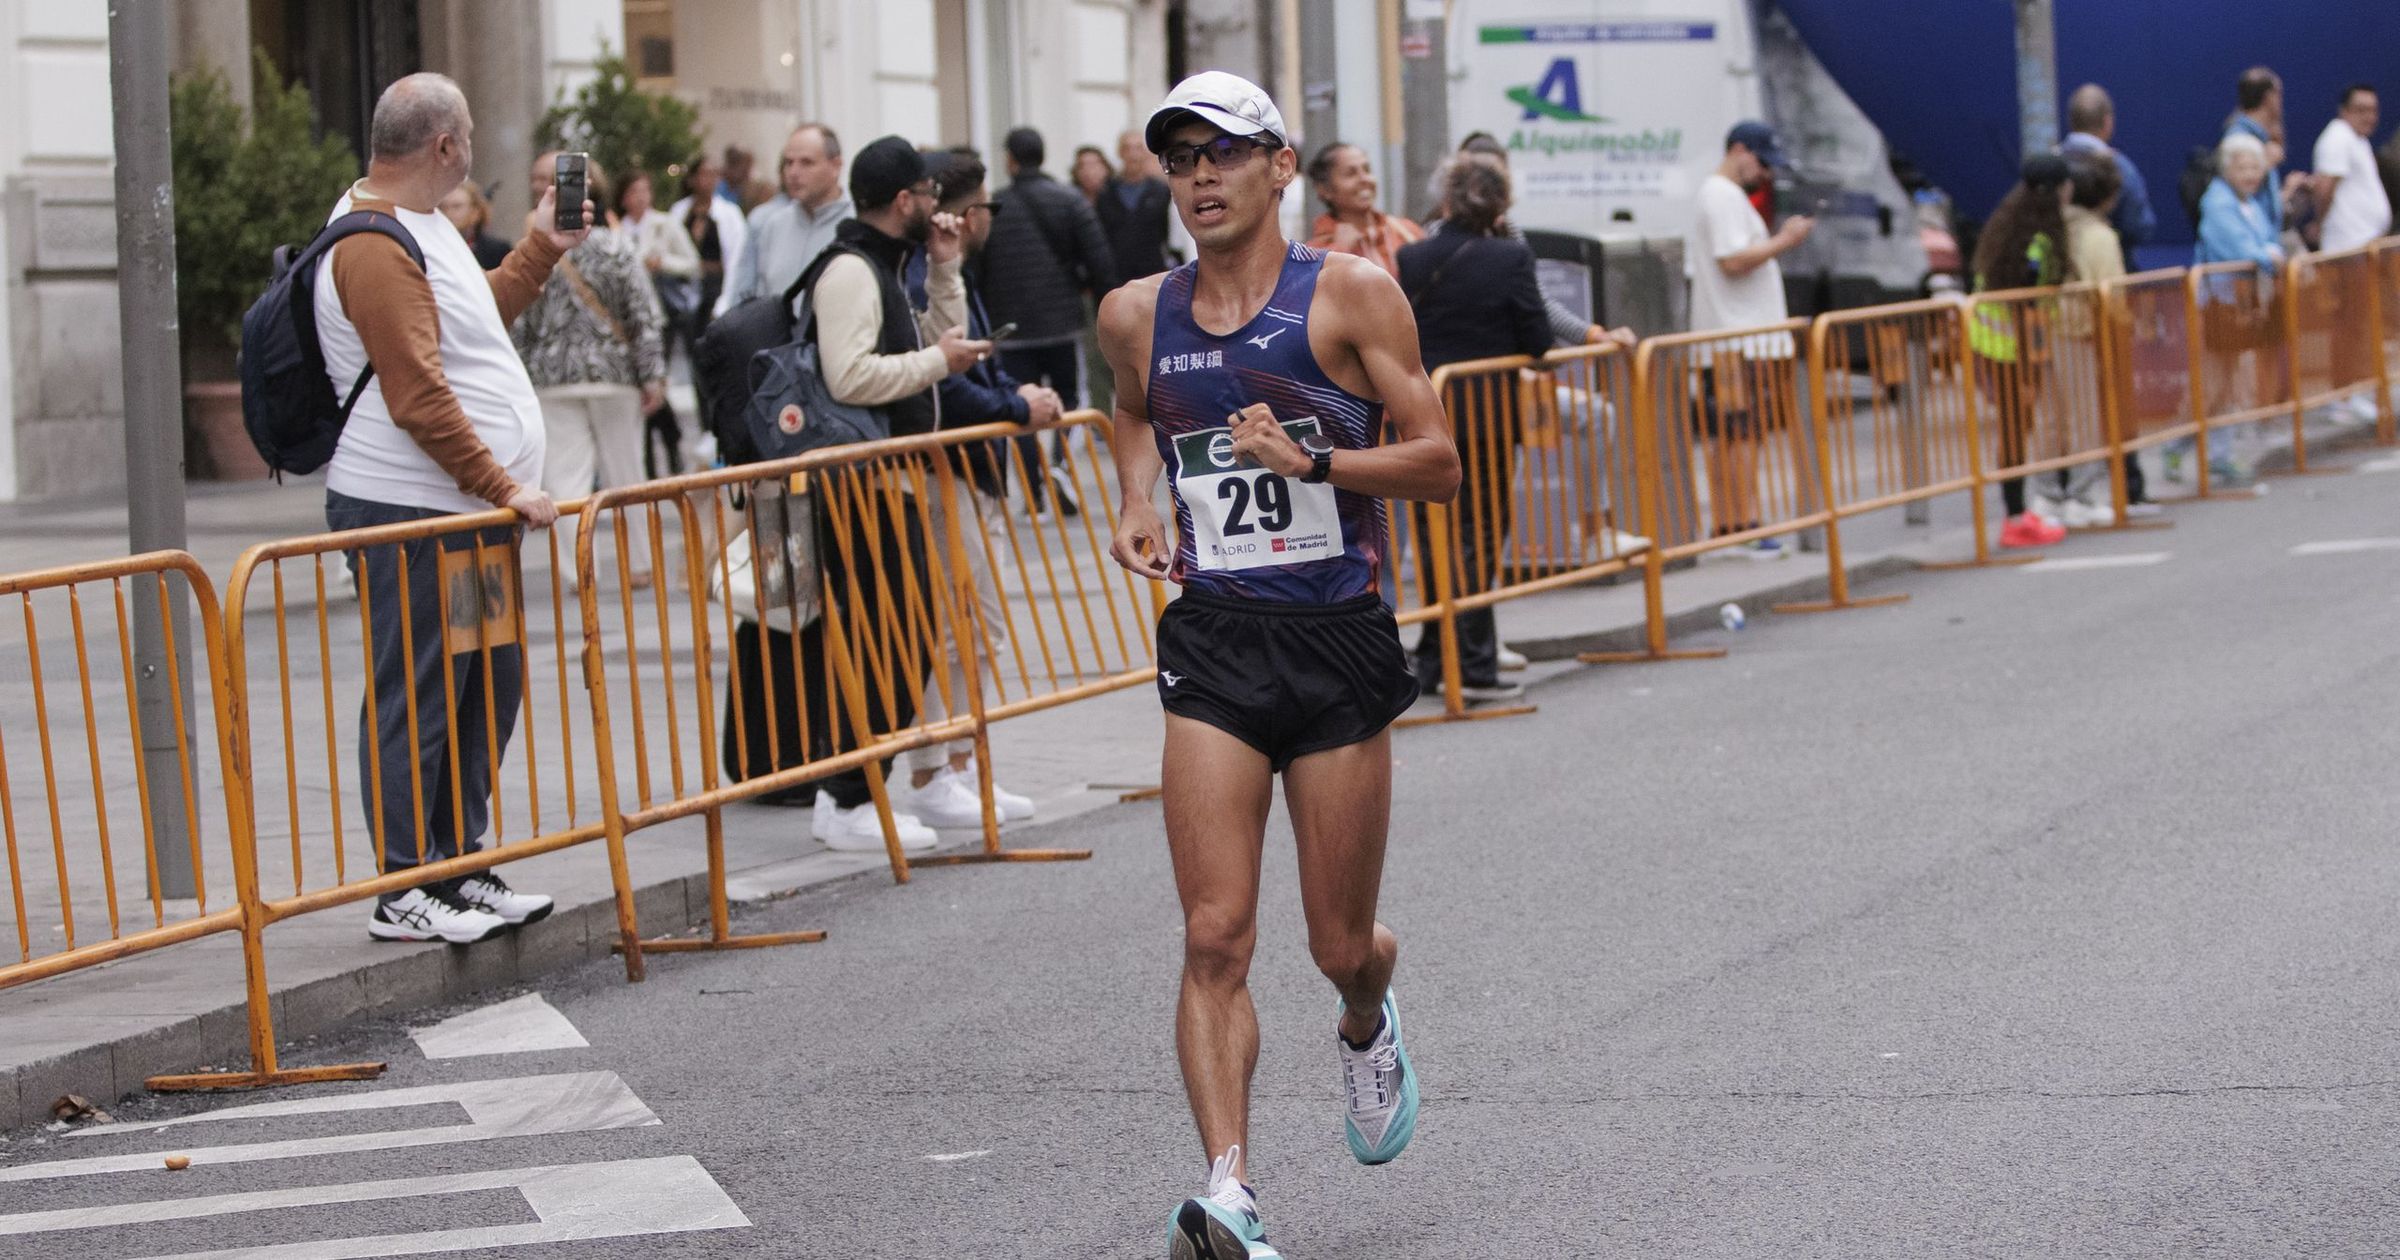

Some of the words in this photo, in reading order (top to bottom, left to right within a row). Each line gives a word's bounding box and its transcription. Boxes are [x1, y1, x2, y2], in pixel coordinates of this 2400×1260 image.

[1508, 128, 1682, 157] Alquimobil
[1158, 350, 1223, 376] 愛知製鋼
[1217, 472, 1293, 537] 29
[1285, 533, 1327, 544] Comunidad
[1287, 543, 1297, 552] de
[1299, 540, 1328, 550] Madrid
[1222, 543, 1257, 557] ADRID
